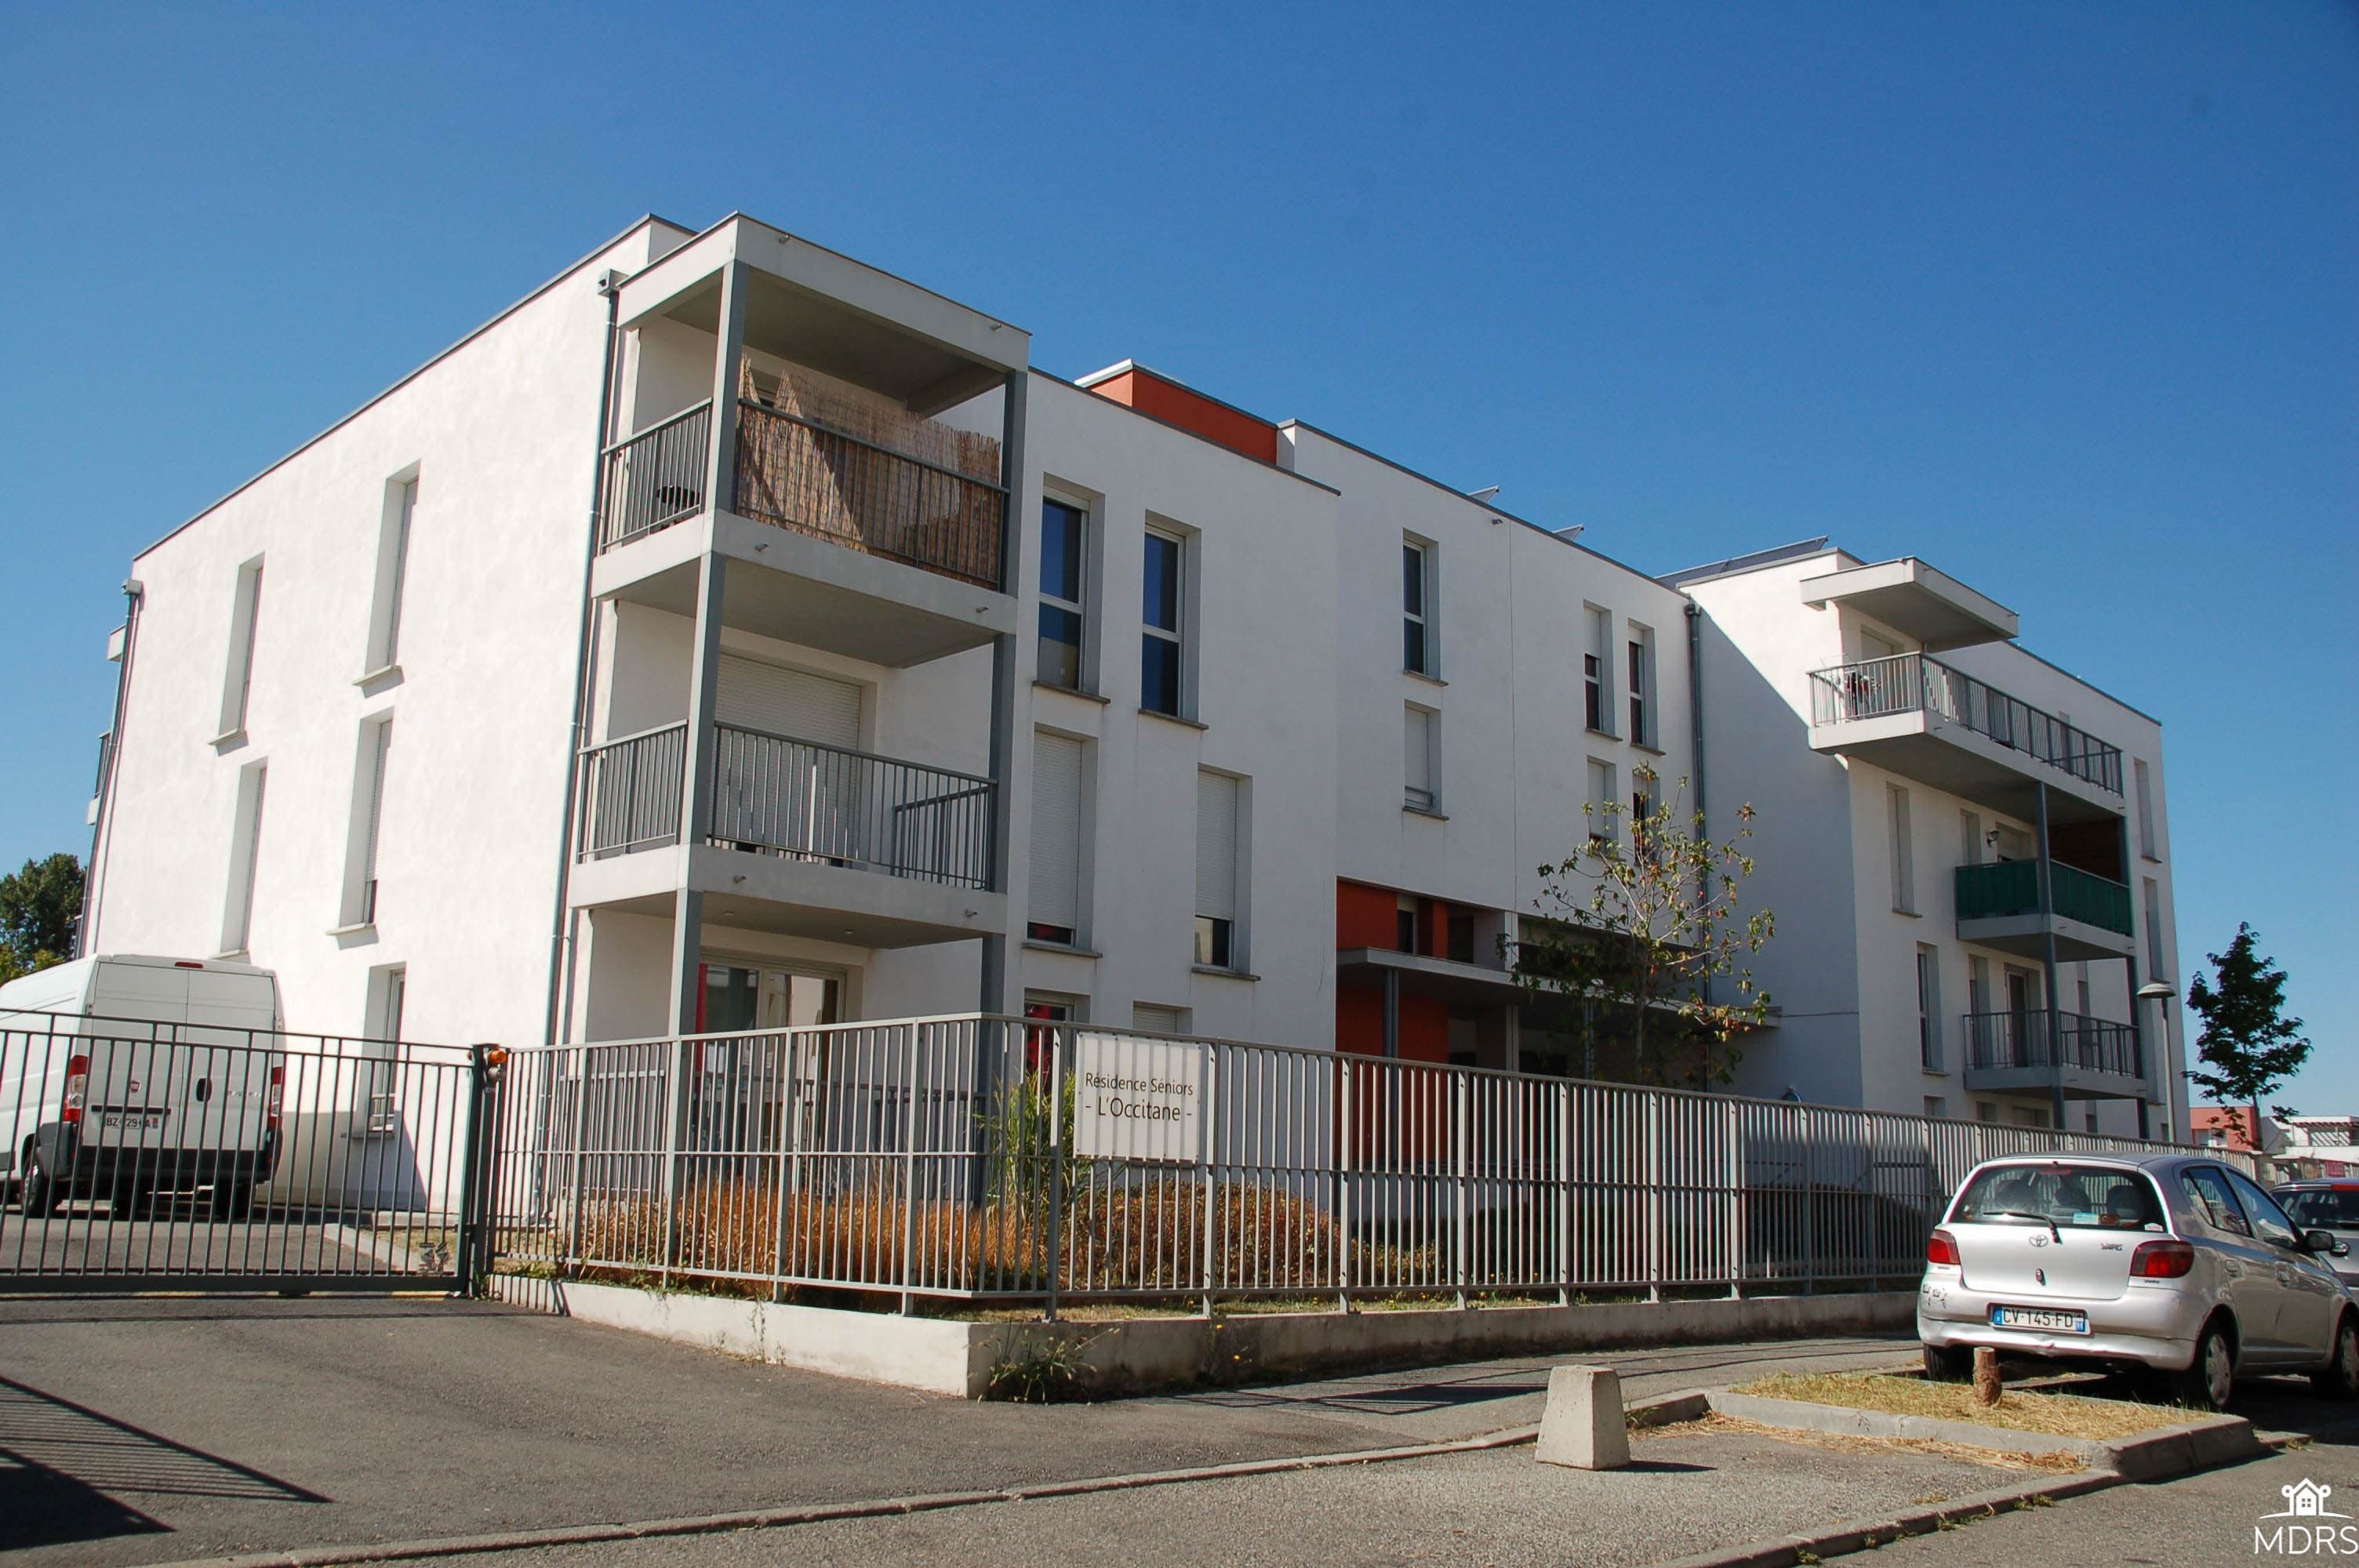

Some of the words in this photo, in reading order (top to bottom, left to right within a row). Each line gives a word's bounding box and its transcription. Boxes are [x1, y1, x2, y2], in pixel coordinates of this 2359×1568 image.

[1085, 1072, 1147, 1092] Résidence
[1150, 1078, 1194, 1096] Séniors
[1098, 1095, 1181, 1121] L'Occitane
